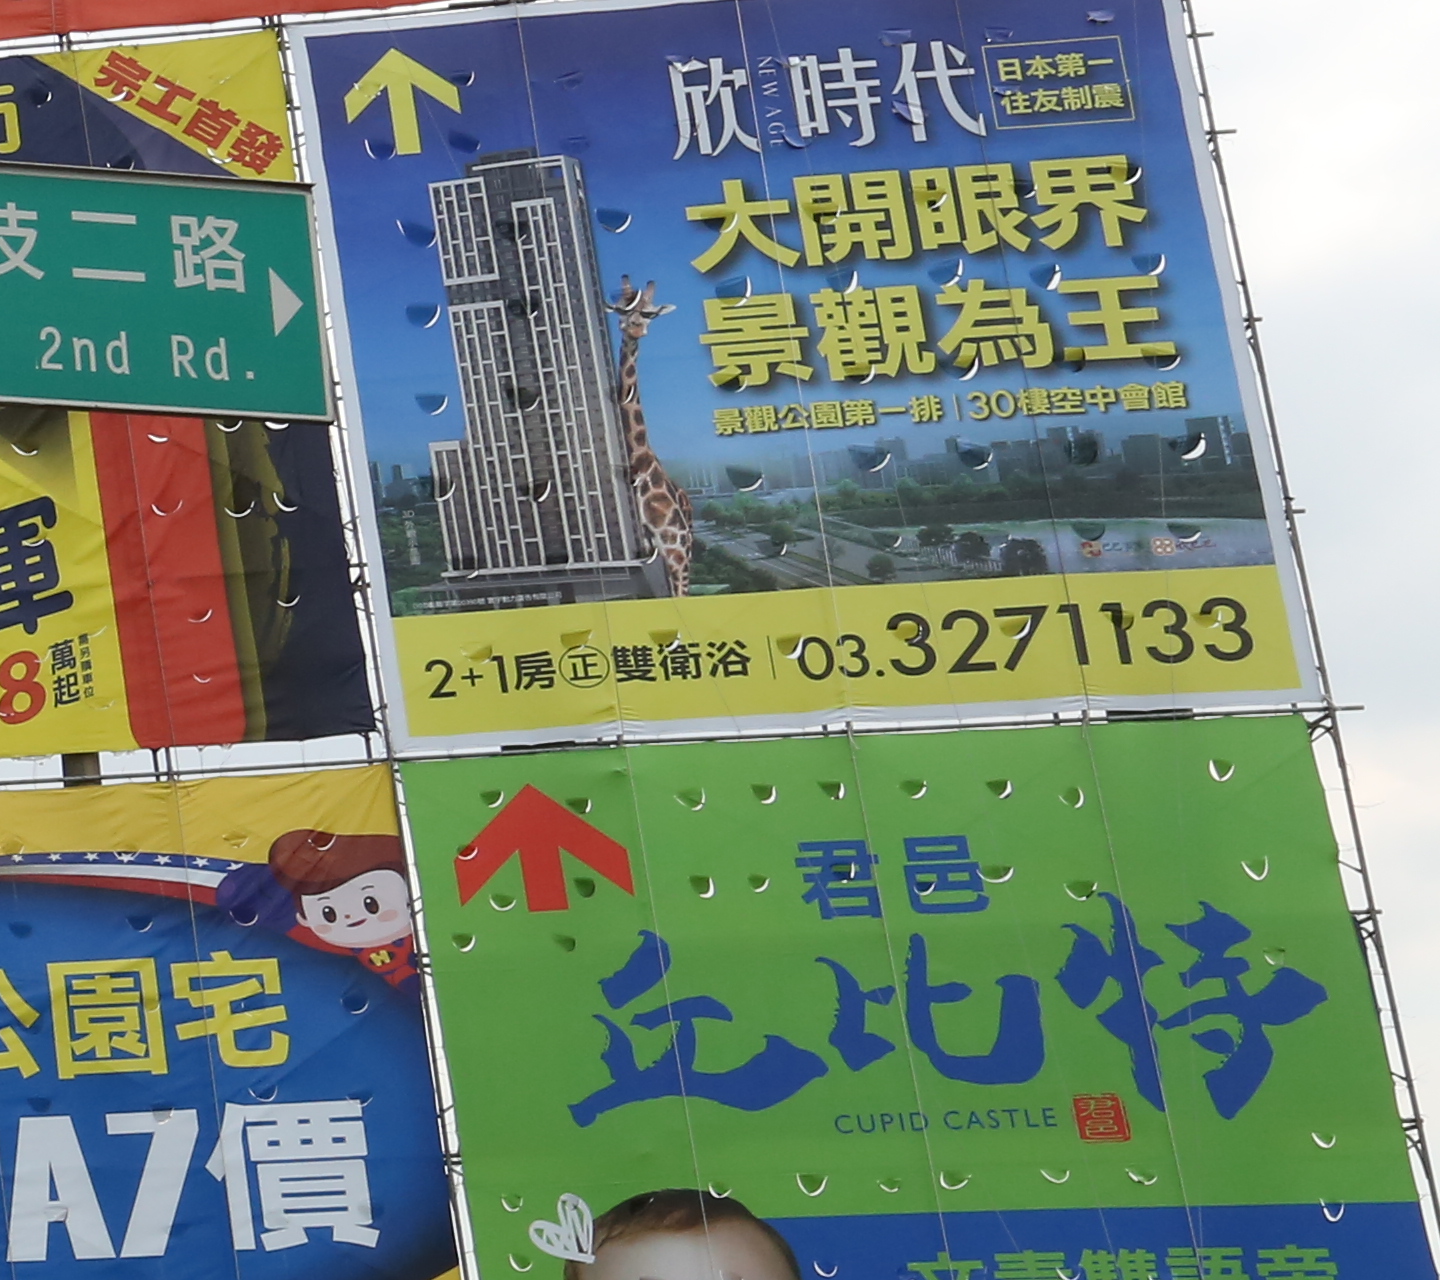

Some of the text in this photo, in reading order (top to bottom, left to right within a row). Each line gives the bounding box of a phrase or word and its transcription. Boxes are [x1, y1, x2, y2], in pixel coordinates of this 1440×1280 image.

[757, 56, 779, 97] NEW
[997, 52, 1115, 82] 日本第一
[1001, 86, 1125, 115] 住友制震
[94, 50, 286, 176] 完工首發
[685, 154, 1147, 274] 大開眼界
[37, 326, 131, 375] 2nd
[170, 334, 256, 381] Rd.
[698, 274, 1177, 389] 景觀為王
[712, 380, 1188, 437] 景觀公園第一排 30樓空中會館
[50, 639, 81, 708] 萬起
[797, 596, 1256, 683] 03.3271133
[794, 835, 992, 919] 君邑
[567, 891, 1328, 1129] 丘比特
[834, 1107, 1057, 1135] CUPID CASTLE
